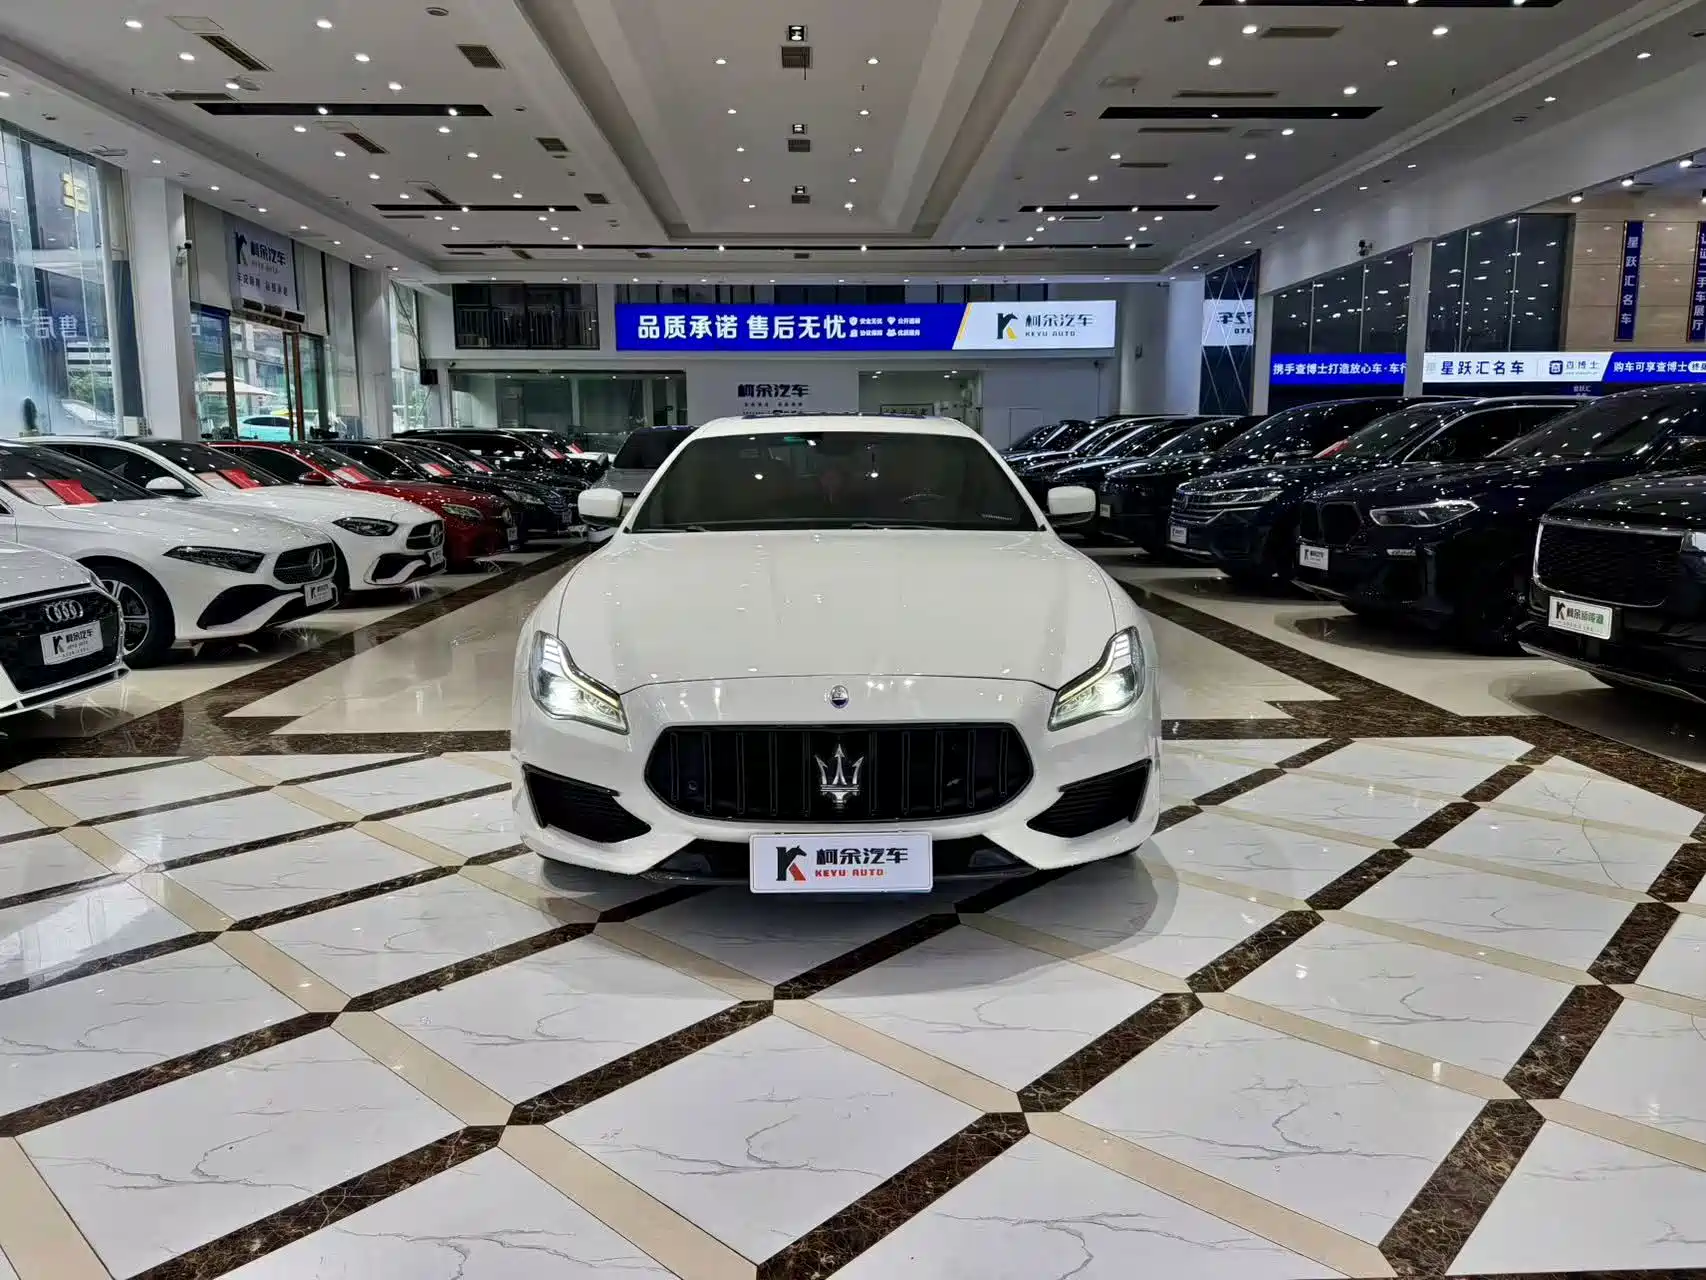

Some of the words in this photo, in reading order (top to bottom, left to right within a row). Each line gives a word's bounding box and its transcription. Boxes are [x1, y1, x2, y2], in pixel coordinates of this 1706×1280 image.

[1620, 236, 1639, 324] 星跃汇名车
[638, 314, 738, 339] 品质承诺
[747, 314, 846, 339] 售后无忧
[1025, 313, 1094, 327] 柯余汽车
[1441, 360, 1524, 375] 星跃汇名车
[1613, 361, 1687, 372] 购车可享查博士
[738, 384, 809, 398] 柯余汽车
[816, 848, 908, 865] 柯余汽车
[815, 869, 846, 877] KEYU
[852, 868, 884, 877] AUTO
